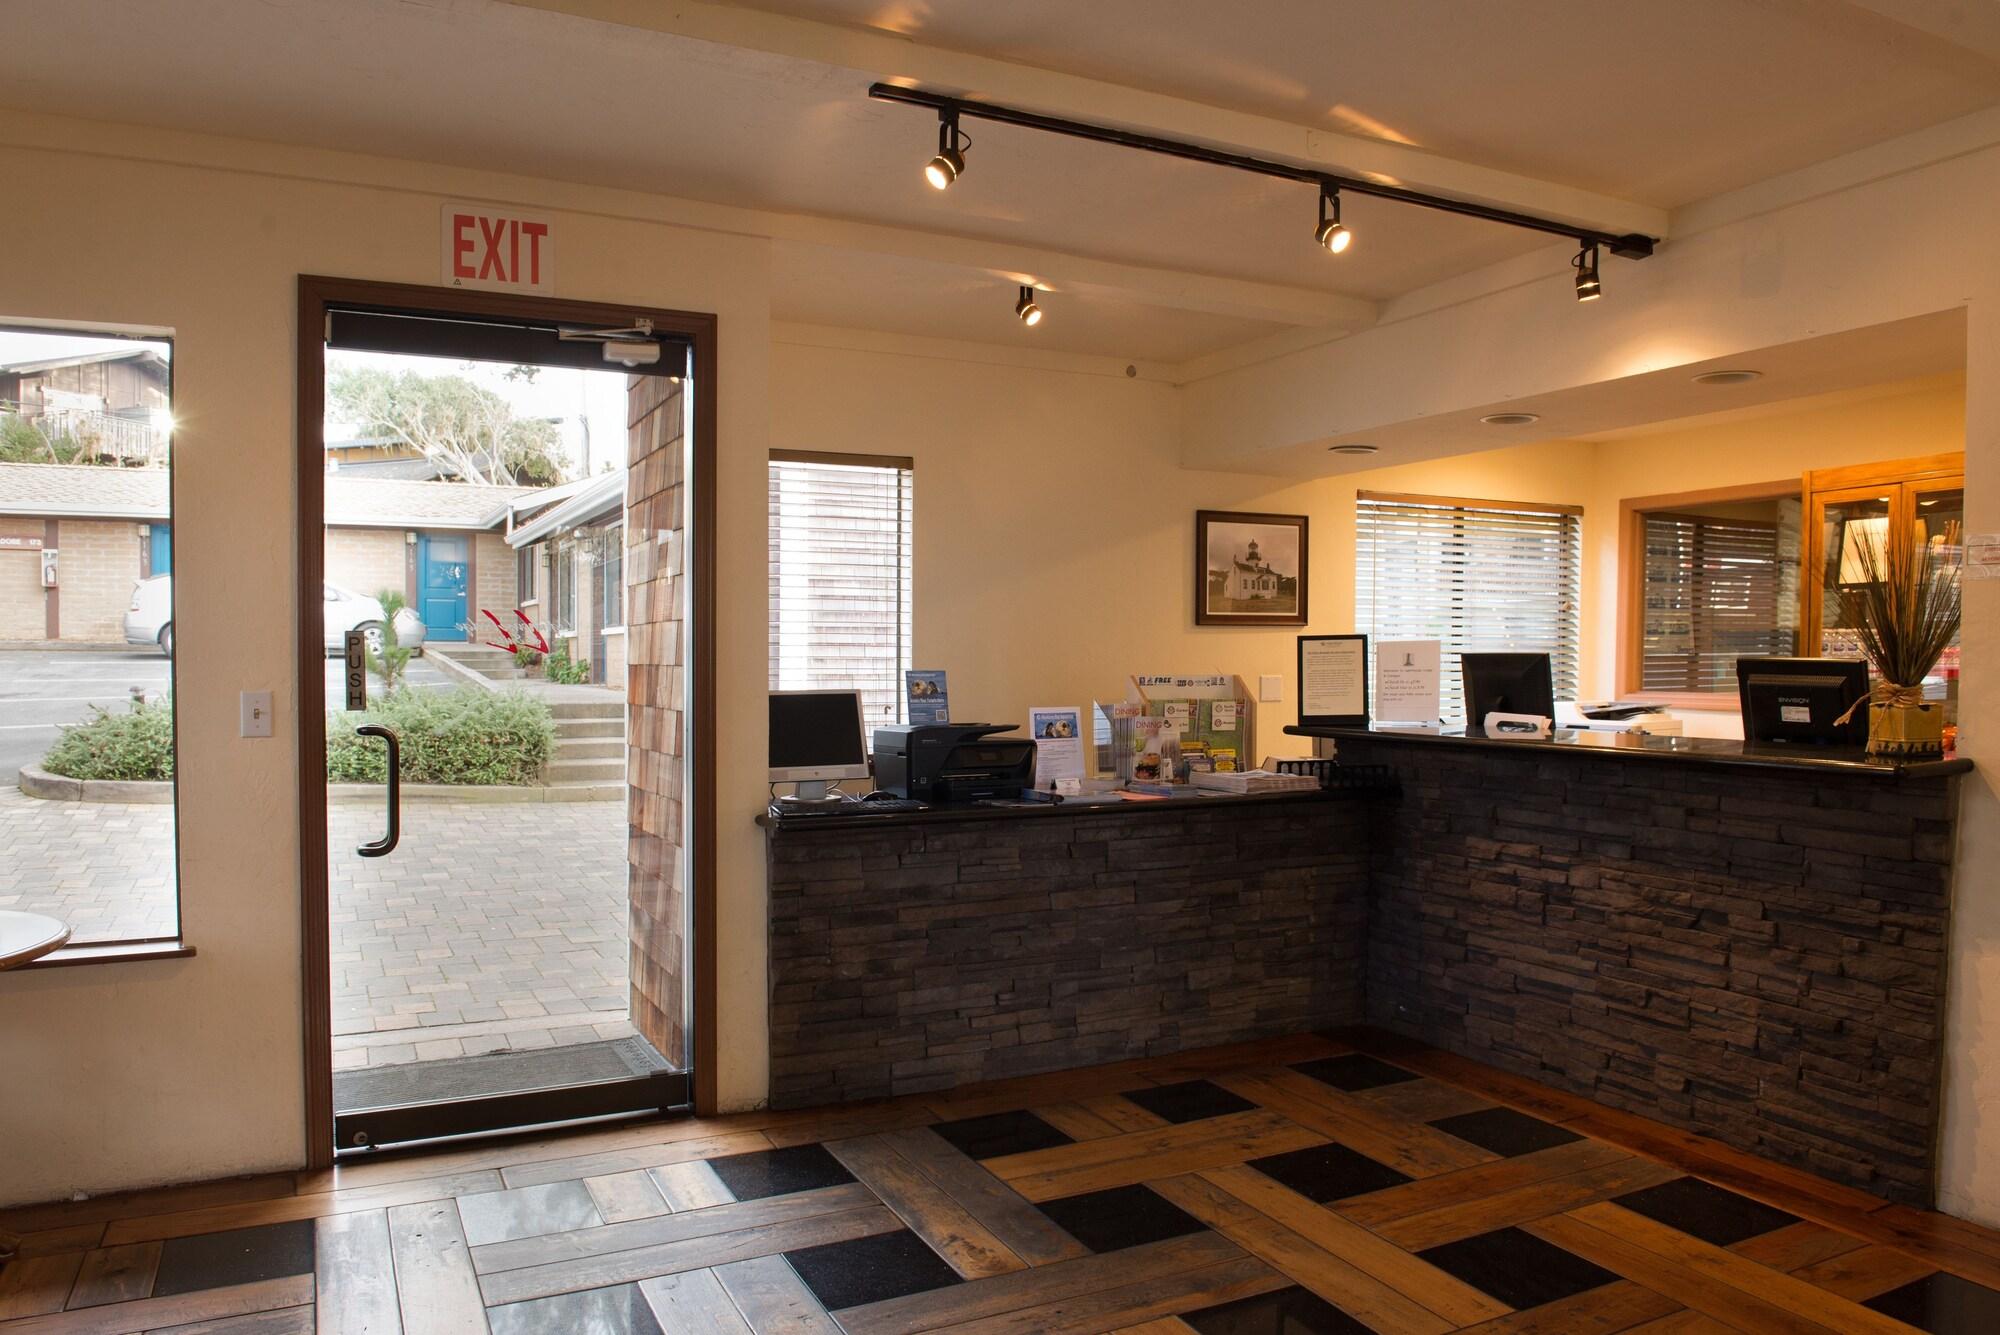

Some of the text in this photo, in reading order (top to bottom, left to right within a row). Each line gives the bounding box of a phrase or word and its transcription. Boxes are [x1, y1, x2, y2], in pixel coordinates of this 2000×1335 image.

[454, 214, 548, 284] EXIT
[349, 636, 362, 706] PUSH
[1154, 676, 1172, 684] FREE
[1115, 707, 1140, 716] DINING
[1135, 720, 1162, 729] DINING
